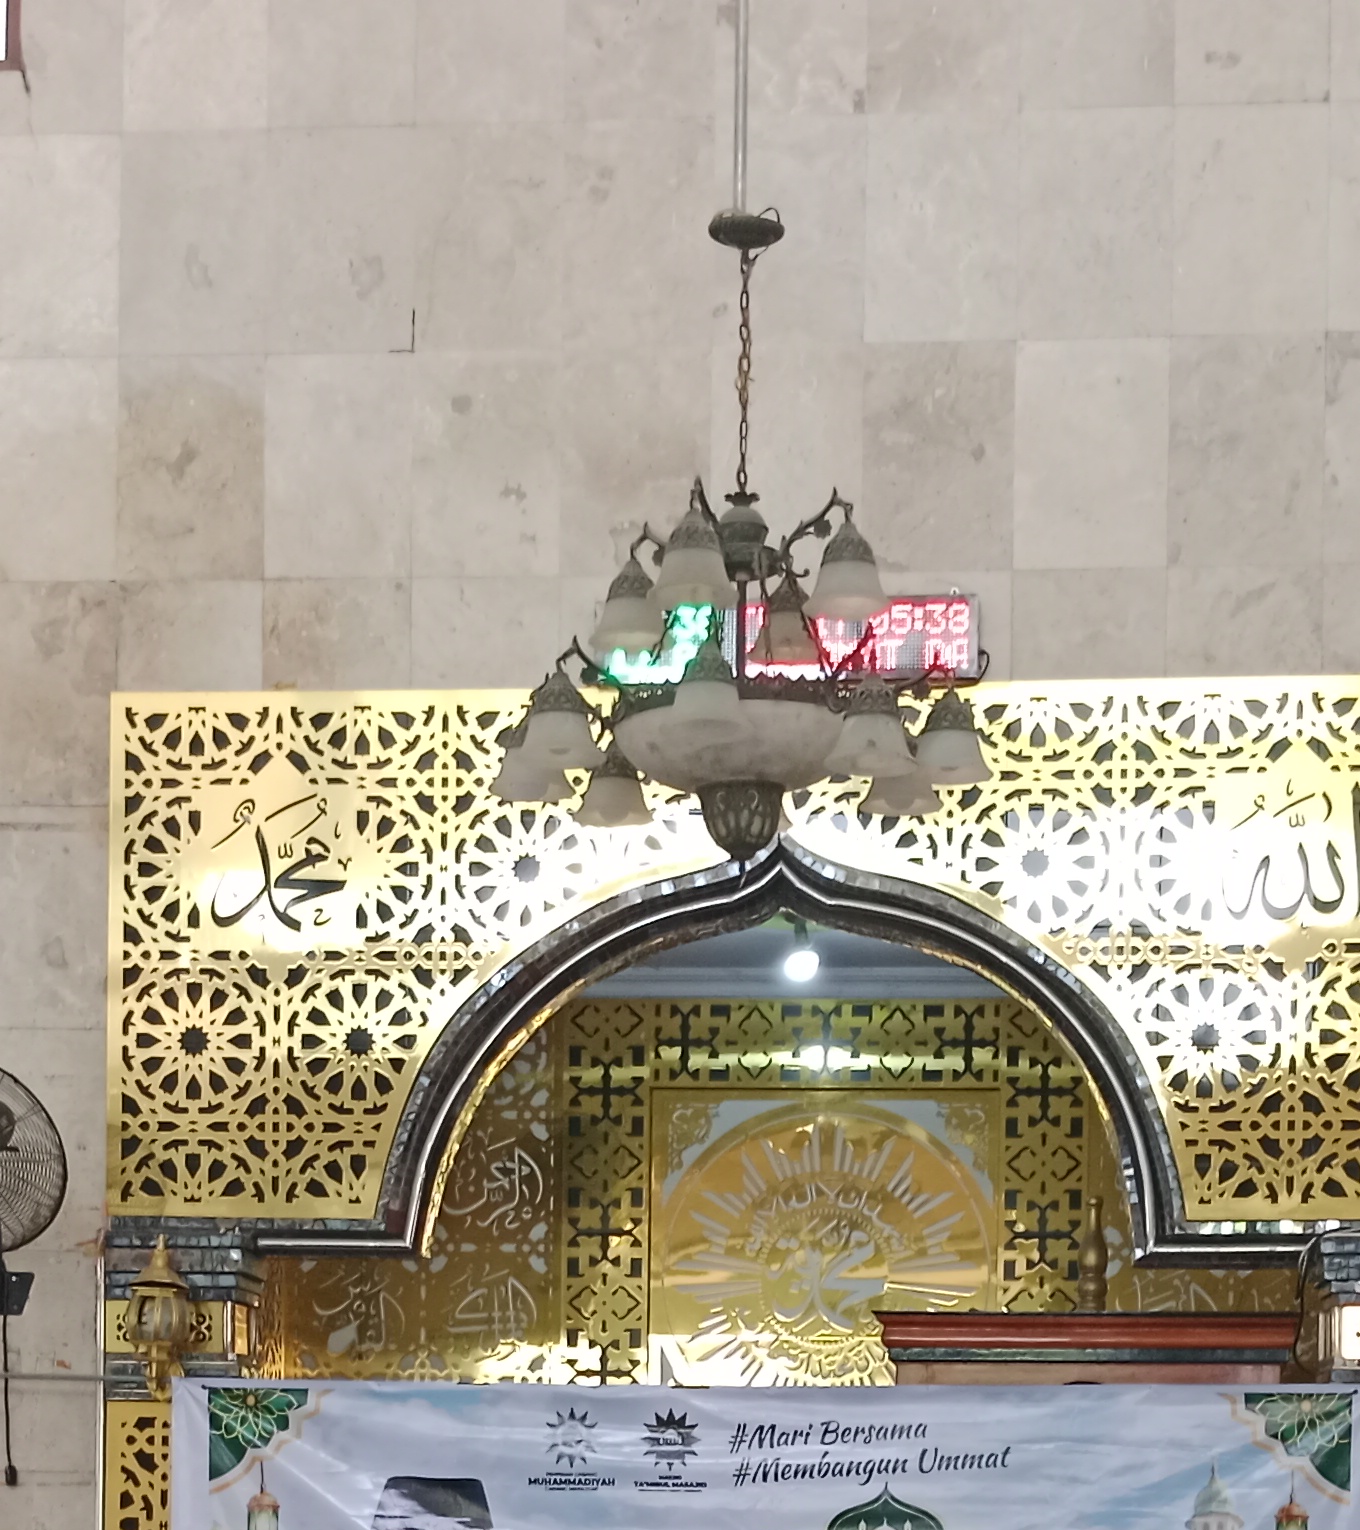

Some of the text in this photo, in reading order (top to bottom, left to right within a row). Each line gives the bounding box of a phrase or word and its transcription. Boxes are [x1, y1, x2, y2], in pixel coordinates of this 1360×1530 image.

[729, 1420, 928, 1453] #Mari Bersama
[528, 1477, 616, 1487] MUHAMMADIYAH
[732, 1446, 1011, 1487] #Membangun Ummat
